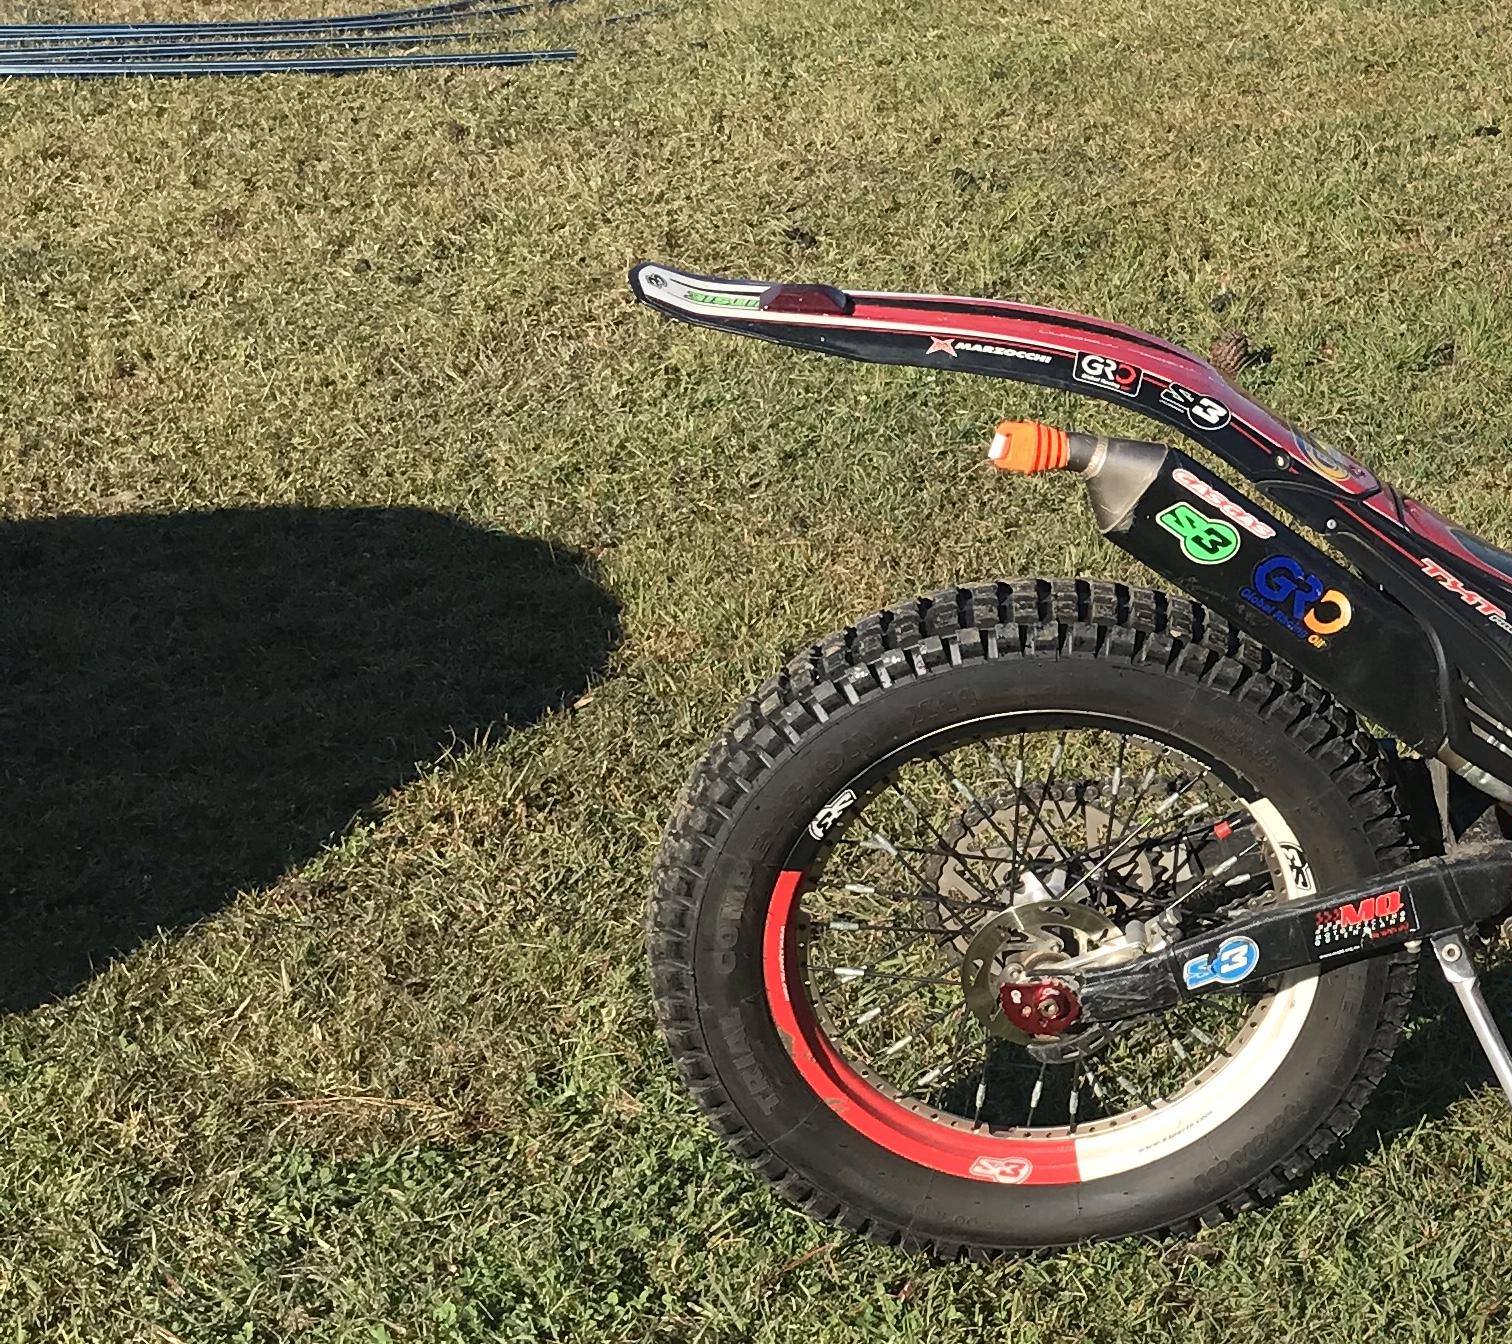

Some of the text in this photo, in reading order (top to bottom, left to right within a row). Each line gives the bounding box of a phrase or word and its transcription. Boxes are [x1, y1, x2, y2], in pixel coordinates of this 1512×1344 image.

[954, 342, 1052, 364] MARZOCCHI
[1157, 503, 1240, 563] S3
[1339, 891, 1405, 928] MQ
[1184, 936, 1259, 990] S3
[969, 1156, 1033, 1184] S3
